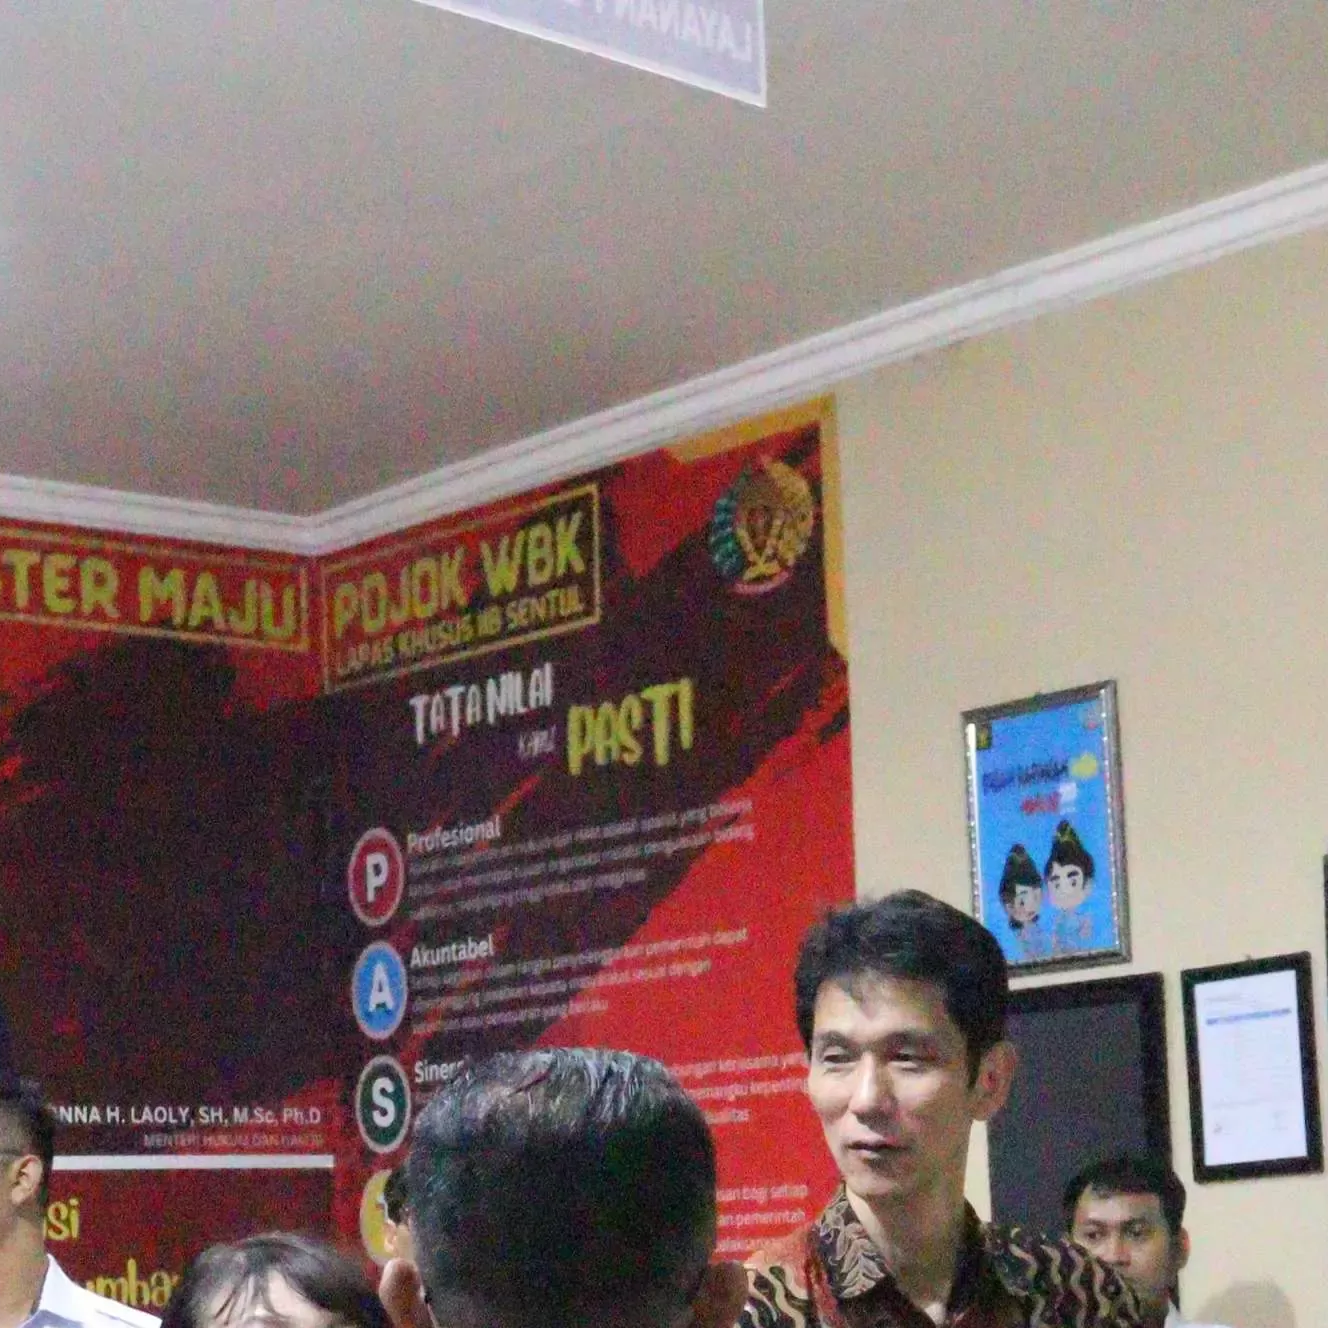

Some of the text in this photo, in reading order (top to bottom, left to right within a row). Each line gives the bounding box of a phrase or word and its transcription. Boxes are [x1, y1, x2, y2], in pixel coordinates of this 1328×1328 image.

[332, 510, 587, 641] POJOK WBK
[137, 562, 301, 643] MAJU
[567, 677, 693, 776] PASTI
[407, 814, 501, 853] Profesional
[365, 852, 388, 903] P
[410, 934, 495, 969] Akuntabel
[368, 960, 395, 1013] A
[51, 1104, 101, 1125] NNA
[106, 1105, 126, 1125] H.
[371, 1076, 396, 1129] S
[43, 1197, 80, 1241] si
